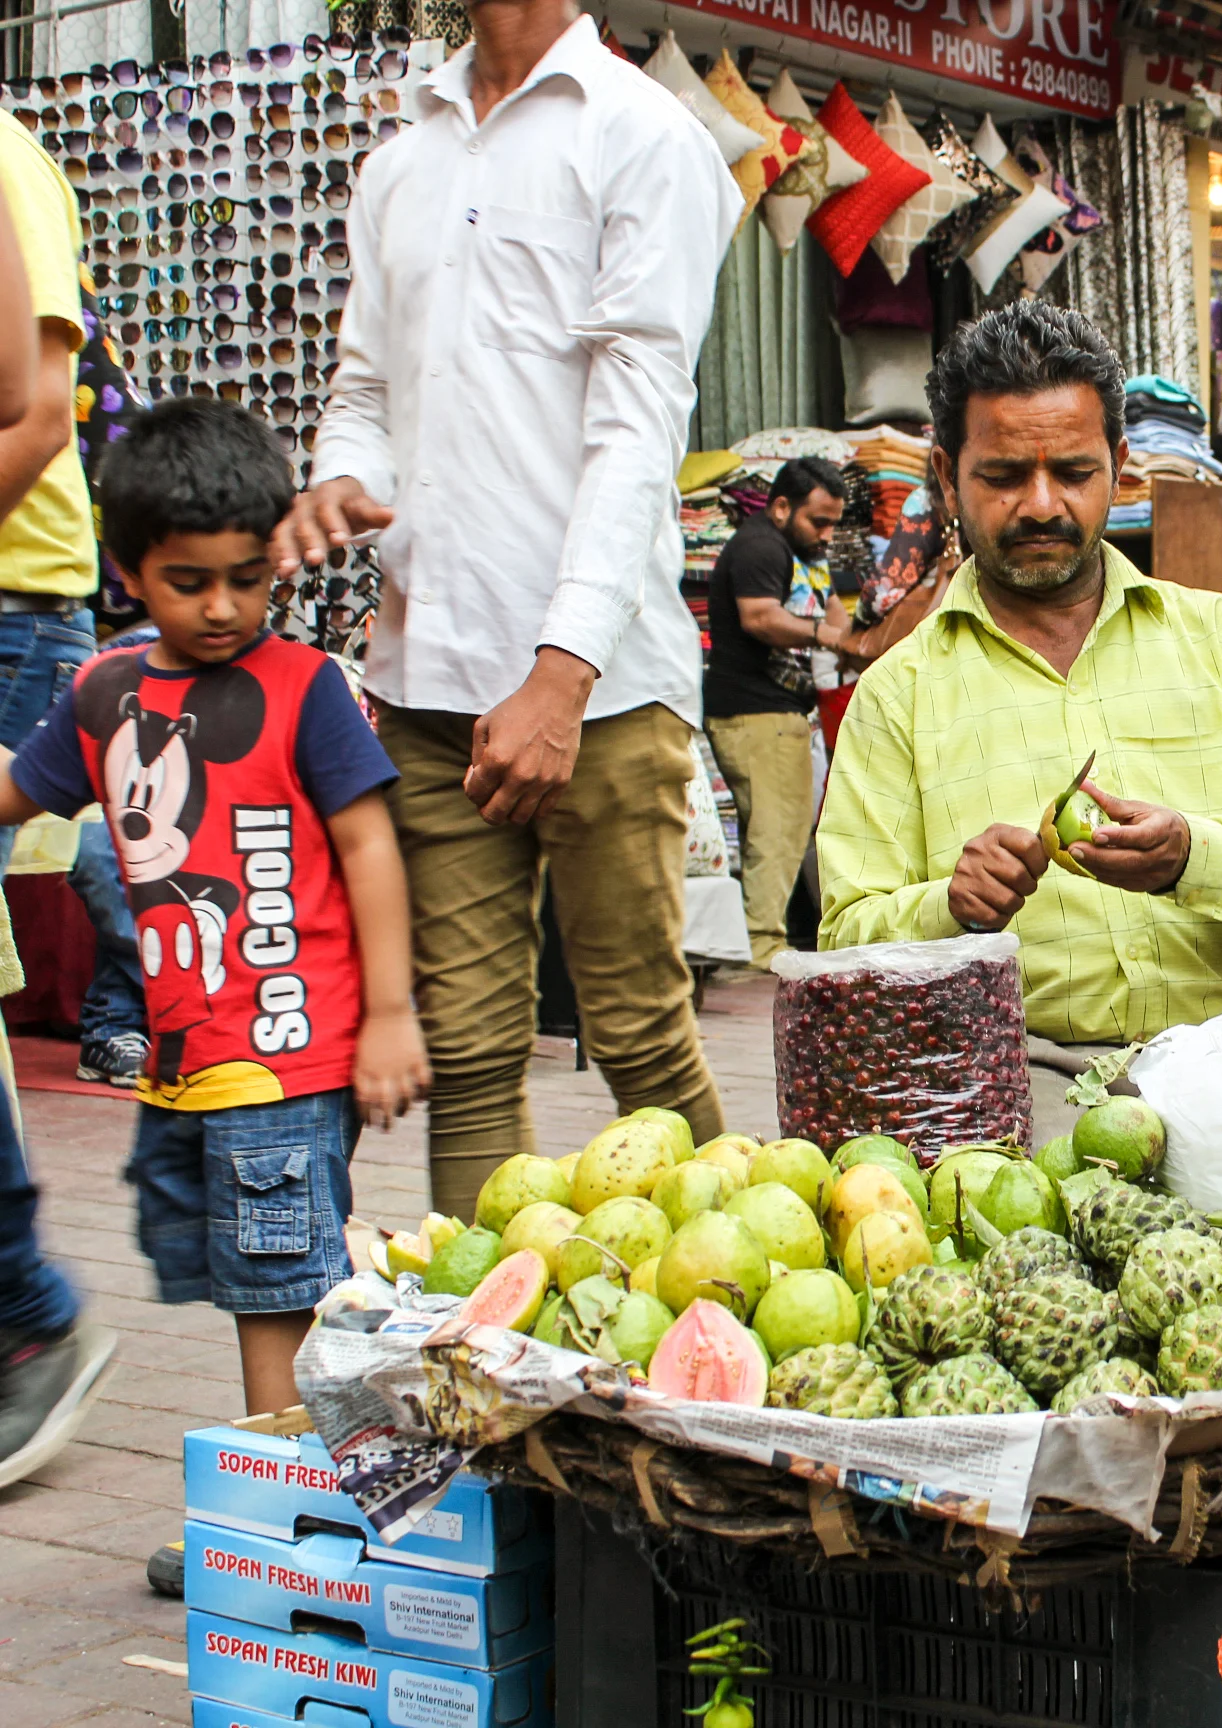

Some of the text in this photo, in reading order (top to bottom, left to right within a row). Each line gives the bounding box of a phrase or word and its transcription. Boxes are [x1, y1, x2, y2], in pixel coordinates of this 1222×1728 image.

[894, 0, 1108, 67] ORE
[811, 0, 912, 56] NAGAR-II
[932, 30, 1004, 82] PHONE
[1021, 57, 1110, 112] 29840899
[218, 1450, 278, 1481] SOPAN
[285, 1463, 341, 1494] FRESH
[204, 1547, 371, 1605] SOPAN FRESH KIWI
[390, 1601, 475, 1623] Shiv International
[401, 1591, 428, 1602] Imported
[416, 1616, 430, 1626] New
[447, 1621, 469, 1632] Market
[431, 1627, 445, 1637] New
[206, 1631, 378, 1690] SOPAN FRESH KIWI
[394, 1687, 474, 1713] Shiv International
